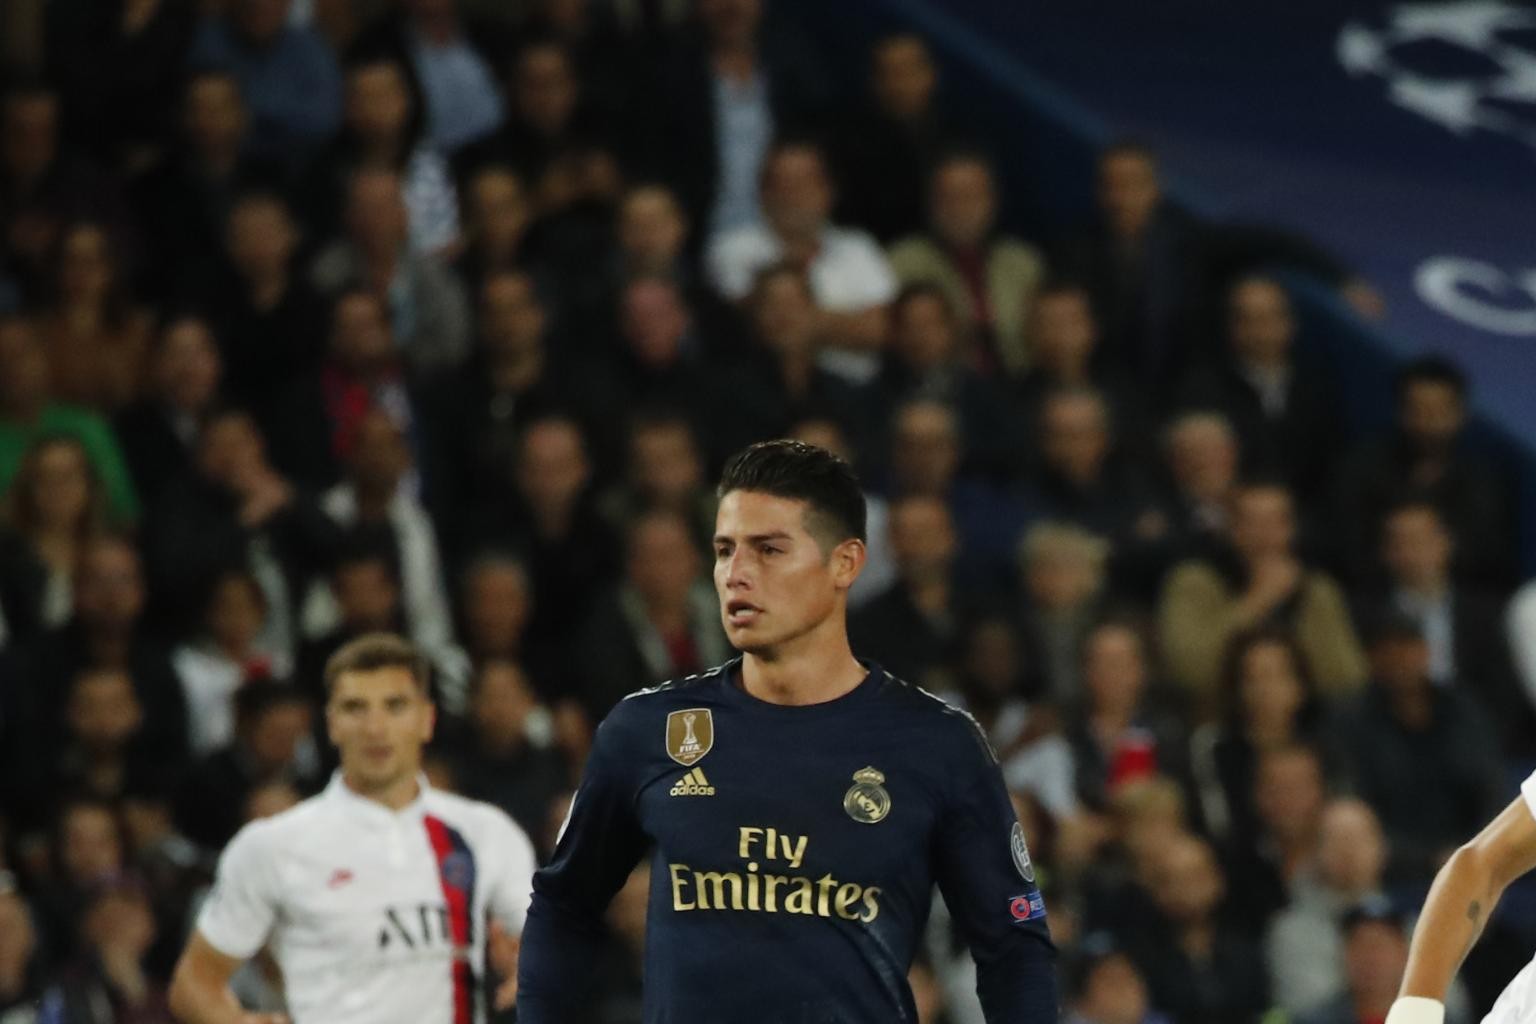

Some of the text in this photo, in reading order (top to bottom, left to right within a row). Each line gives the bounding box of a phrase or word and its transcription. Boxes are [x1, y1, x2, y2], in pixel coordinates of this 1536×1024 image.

[670, 784, 715, 796] adidas
[739, 827, 808, 868] Fly
[669, 862, 882, 923] Emirates
